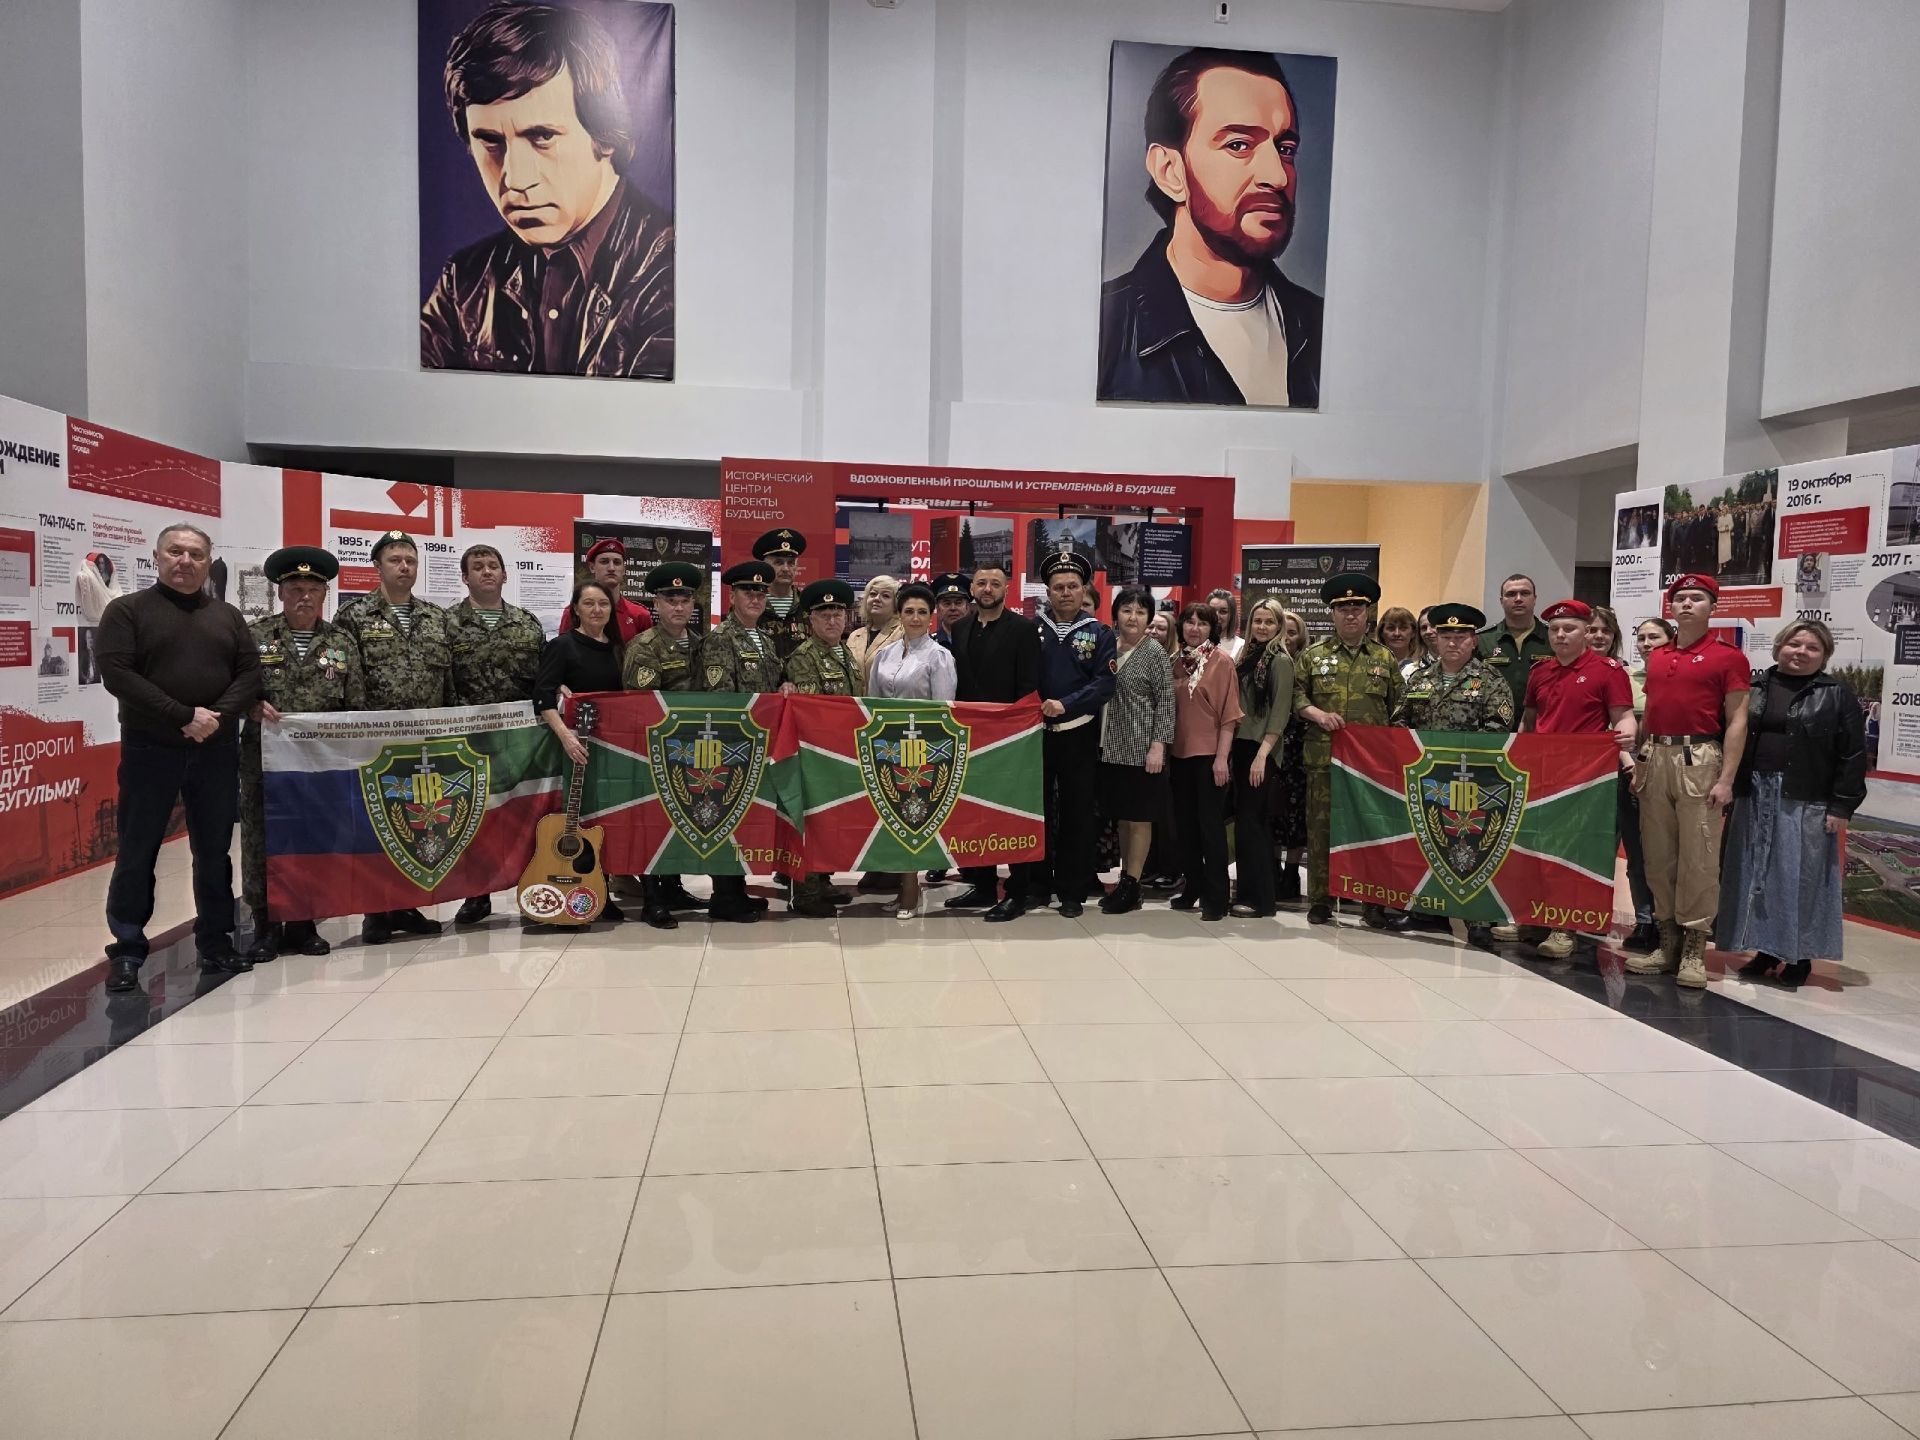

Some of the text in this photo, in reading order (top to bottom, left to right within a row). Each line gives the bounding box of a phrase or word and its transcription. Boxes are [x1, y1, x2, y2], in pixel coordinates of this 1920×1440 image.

[725, 470, 814, 484] ИСТОРИЧЕСКИЙ
[849, 473, 1177, 496] ВДОХНОВЛЕННЫЙ ПРОШЛЫМ И УСТРЕМЛЕННЫЙ В БУДУЩЕЕ
[1787, 472, 1852, 492] 19 октября
[725, 483, 772, 494] ЦЕНТР И
[725, 496, 778, 507] ПРОЕКТЫ
[1786, 493, 1822, 508] 2016 г.
[38, 513, 76, 531] 1741-1745
[725, 509, 785, 520] БУДУЩЕГО
[337, 535, 372, 548] 1895 г.
[424, 542, 447, 553] 1898
[136, 557, 152, 571] 1774
[516, 561, 544, 571] 1911 г.
[1615, 554, 1636, 566] 2000
[1871, 553, 1913, 567] 2017 г.
[1248, 577, 1299, 585] Мобильный
[57, 601, 75, 615] 1770
[1795, 609, 1832, 622] 2010 г.
[1892, 692, 1920, 706] 2018
[288, 717, 544, 740] «СОДРУЖЕСТВО ПОГРАНИЧНИКОВ» РЕСПУБЛИКИ ТАТАРСТ
[317, 710, 524, 731] РЕГИОНАЛЬНАЯ ОБЩЕСТВЕННАЯ ОРГАНИЗАЦИЯ
[12, 735, 74, 767] ДОРОГИ
[694, 739, 722, 769] ПВ
[900, 739, 927, 768] ПВ
[412, 772, 443, 804] ПВ
[651, 743, 698, 843] СОДРУЖЕСТВО
[713, 745, 764, 843] ПОГРАНИЧНИКОВ
[860, 744, 908, 839] СОДРУЖЕСТВО
[922, 742, 968, 837] ПОГРАНИЧНИКОВ
[1450, 780, 1479, 812] ПВ
[366, 781, 423, 880] СОДРУЖЕСТВО
[438, 772, 487, 875] ПОГРАНИЧНИКОВ
[1409, 782, 1454, 886] СОДРУЖЕСТВО
[947, 831, 1037, 857] Аксубаево
[1470, 789, 1525, 890] ПОГРАНИЧНИКОВ
[1339, 874, 1446, 911] Татарстан
[1530, 900, 1610, 930] Уруссу
